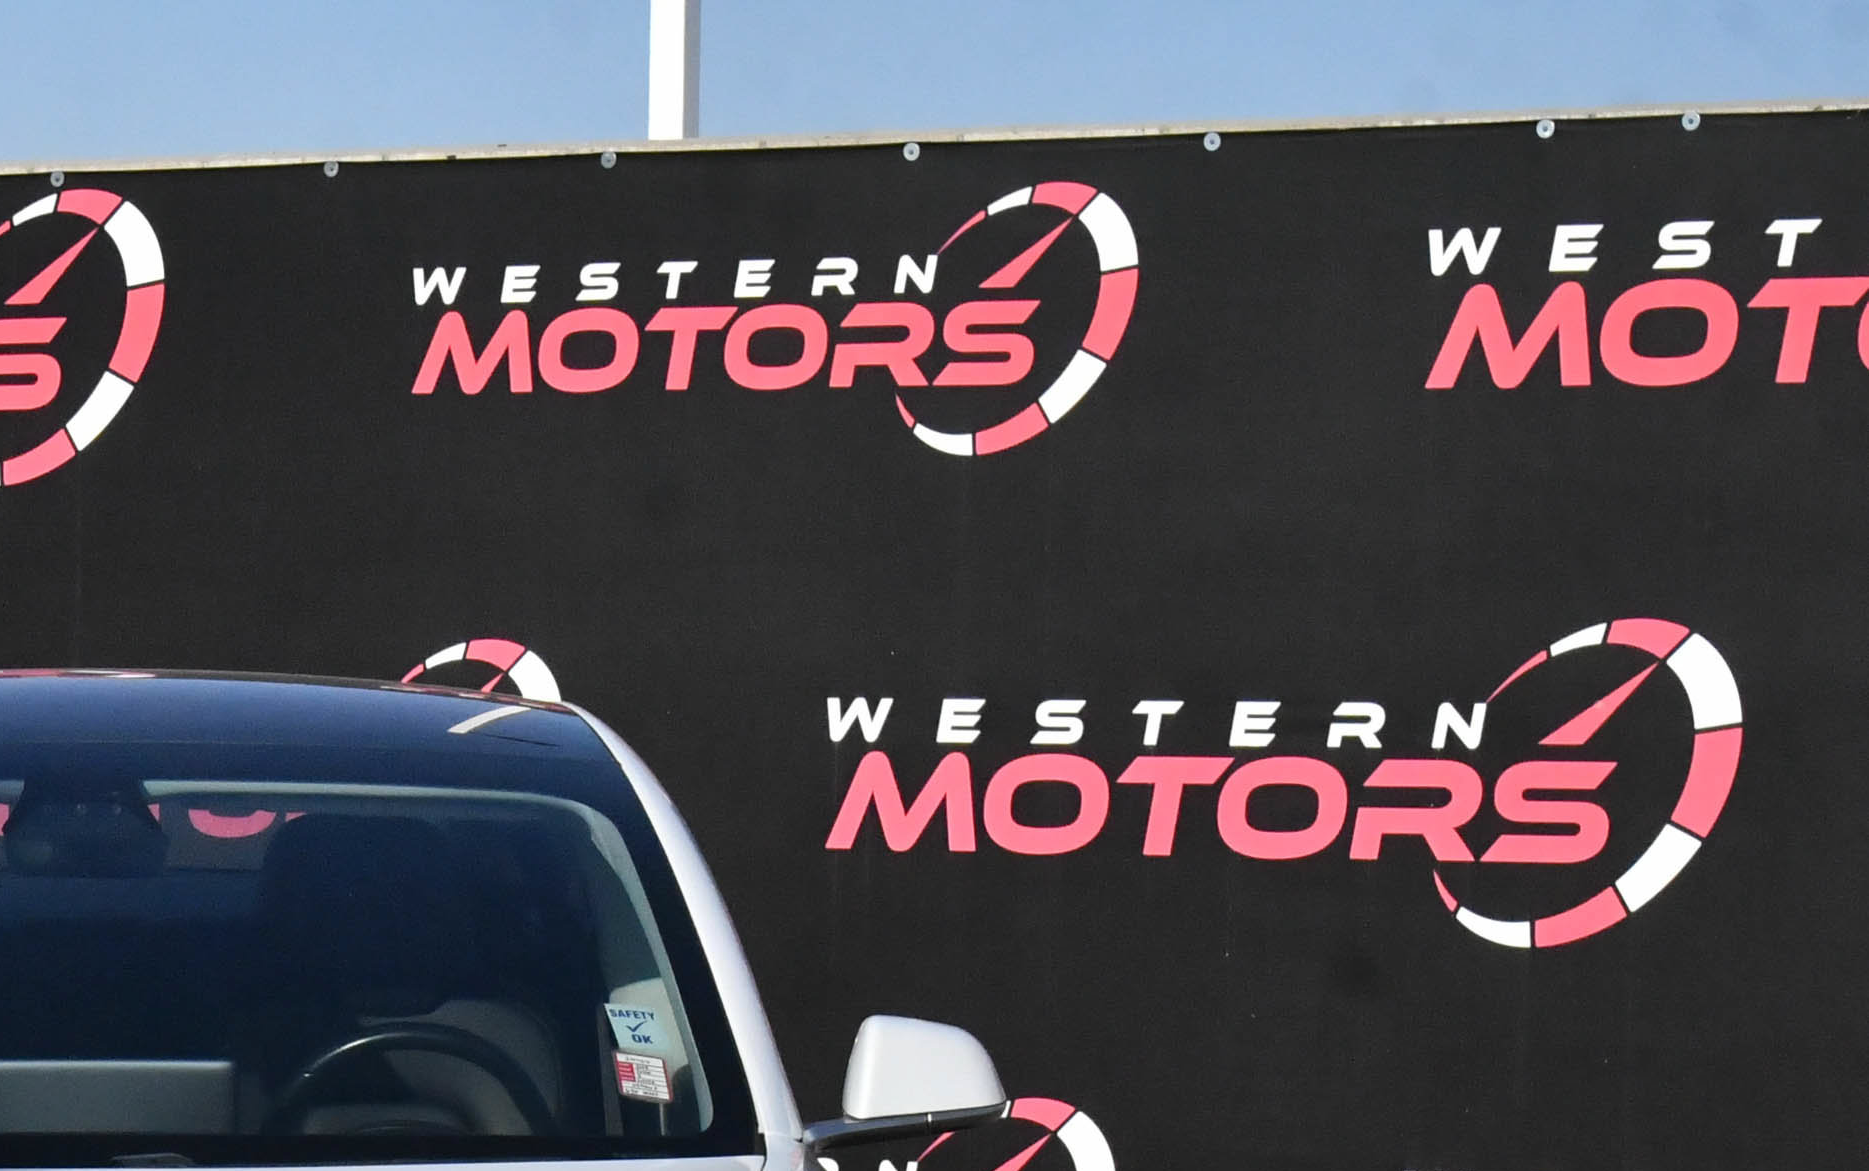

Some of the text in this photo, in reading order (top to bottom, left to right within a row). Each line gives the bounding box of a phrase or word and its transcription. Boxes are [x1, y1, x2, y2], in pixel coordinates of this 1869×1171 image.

[1428, 218, 1823, 276] WEST
[413, 255, 938, 306] WESTERN
[412, 299, 1041, 395] MOTORS
[1425, 276, 1869, 390] MOT
[826, 697, 1487, 750] WESTERN
[825, 751, 1618, 864] MOTORS
[609, 1008, 654, 1020] SAFETY
[631, 1034, 653, 1044] OK
